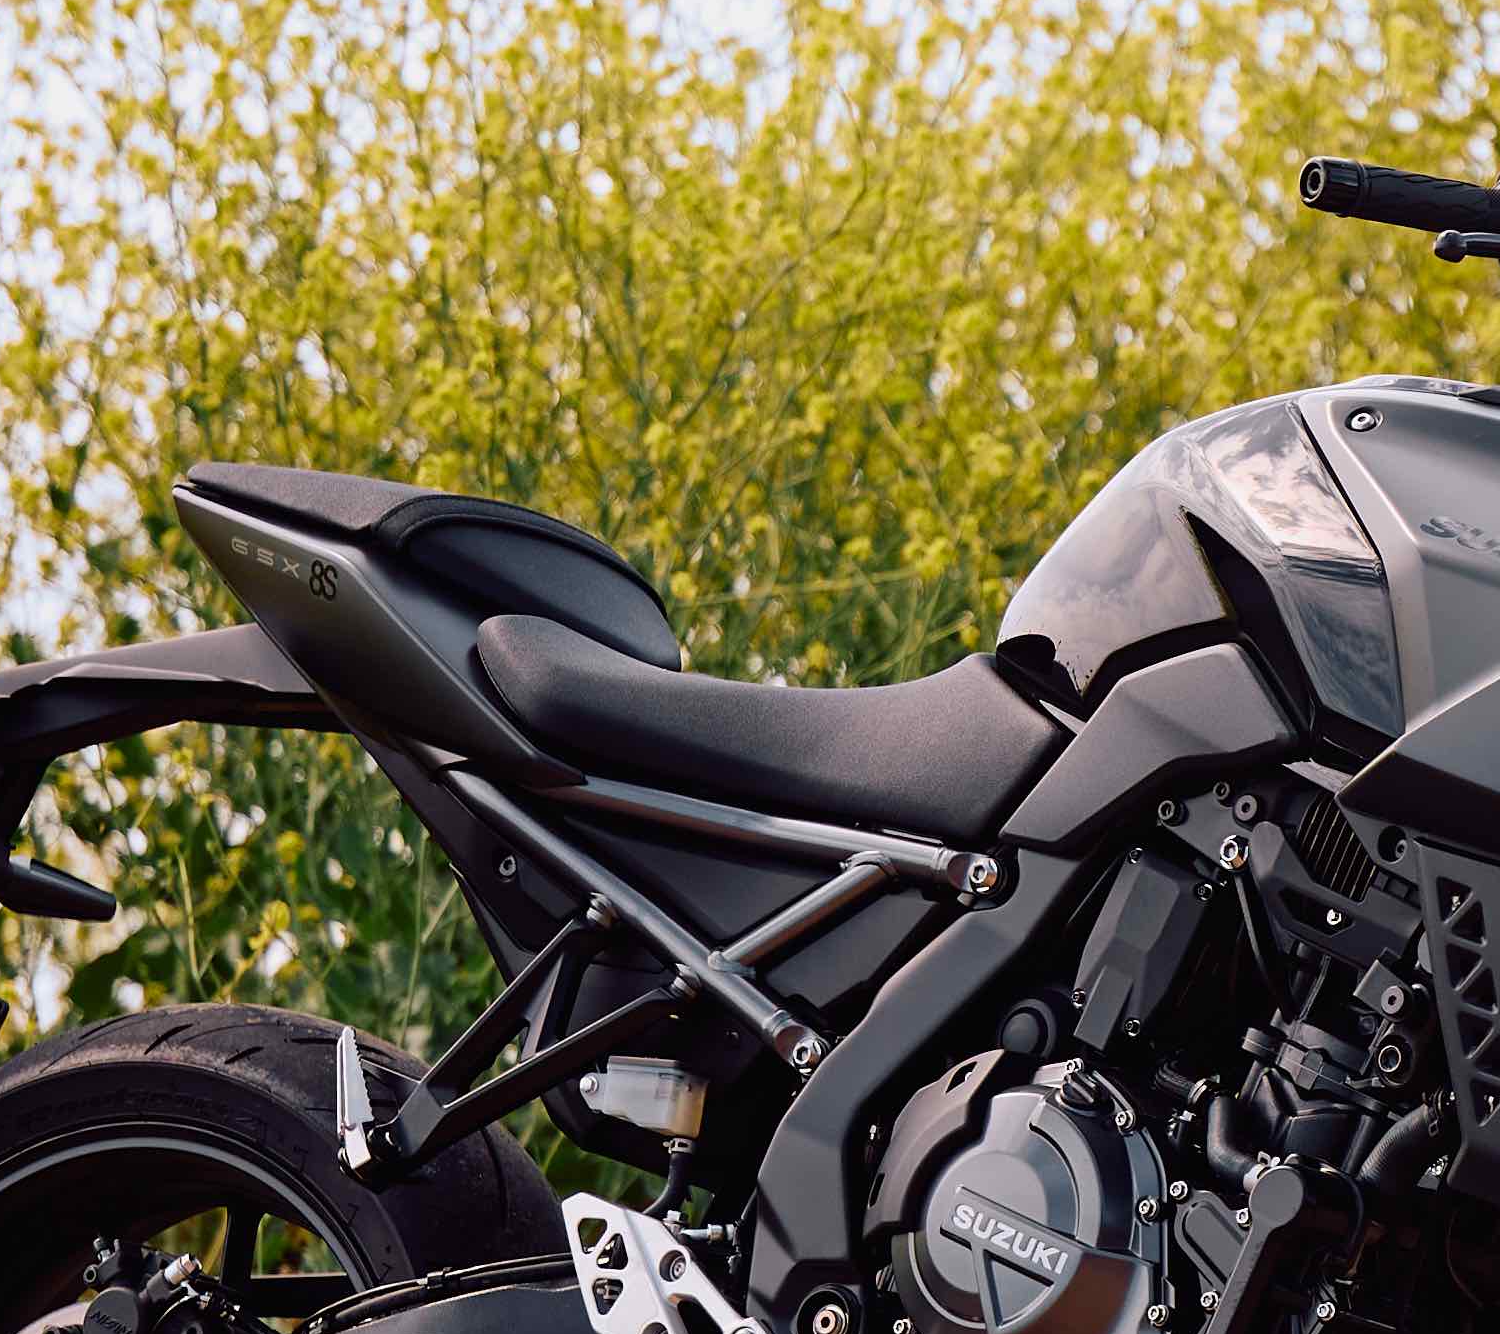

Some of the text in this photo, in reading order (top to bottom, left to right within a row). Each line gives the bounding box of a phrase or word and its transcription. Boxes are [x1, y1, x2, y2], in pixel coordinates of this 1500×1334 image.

[231, 537, 338, 601] GSX 8S
[953, 1204, 1069, 1274] SUZUKI
